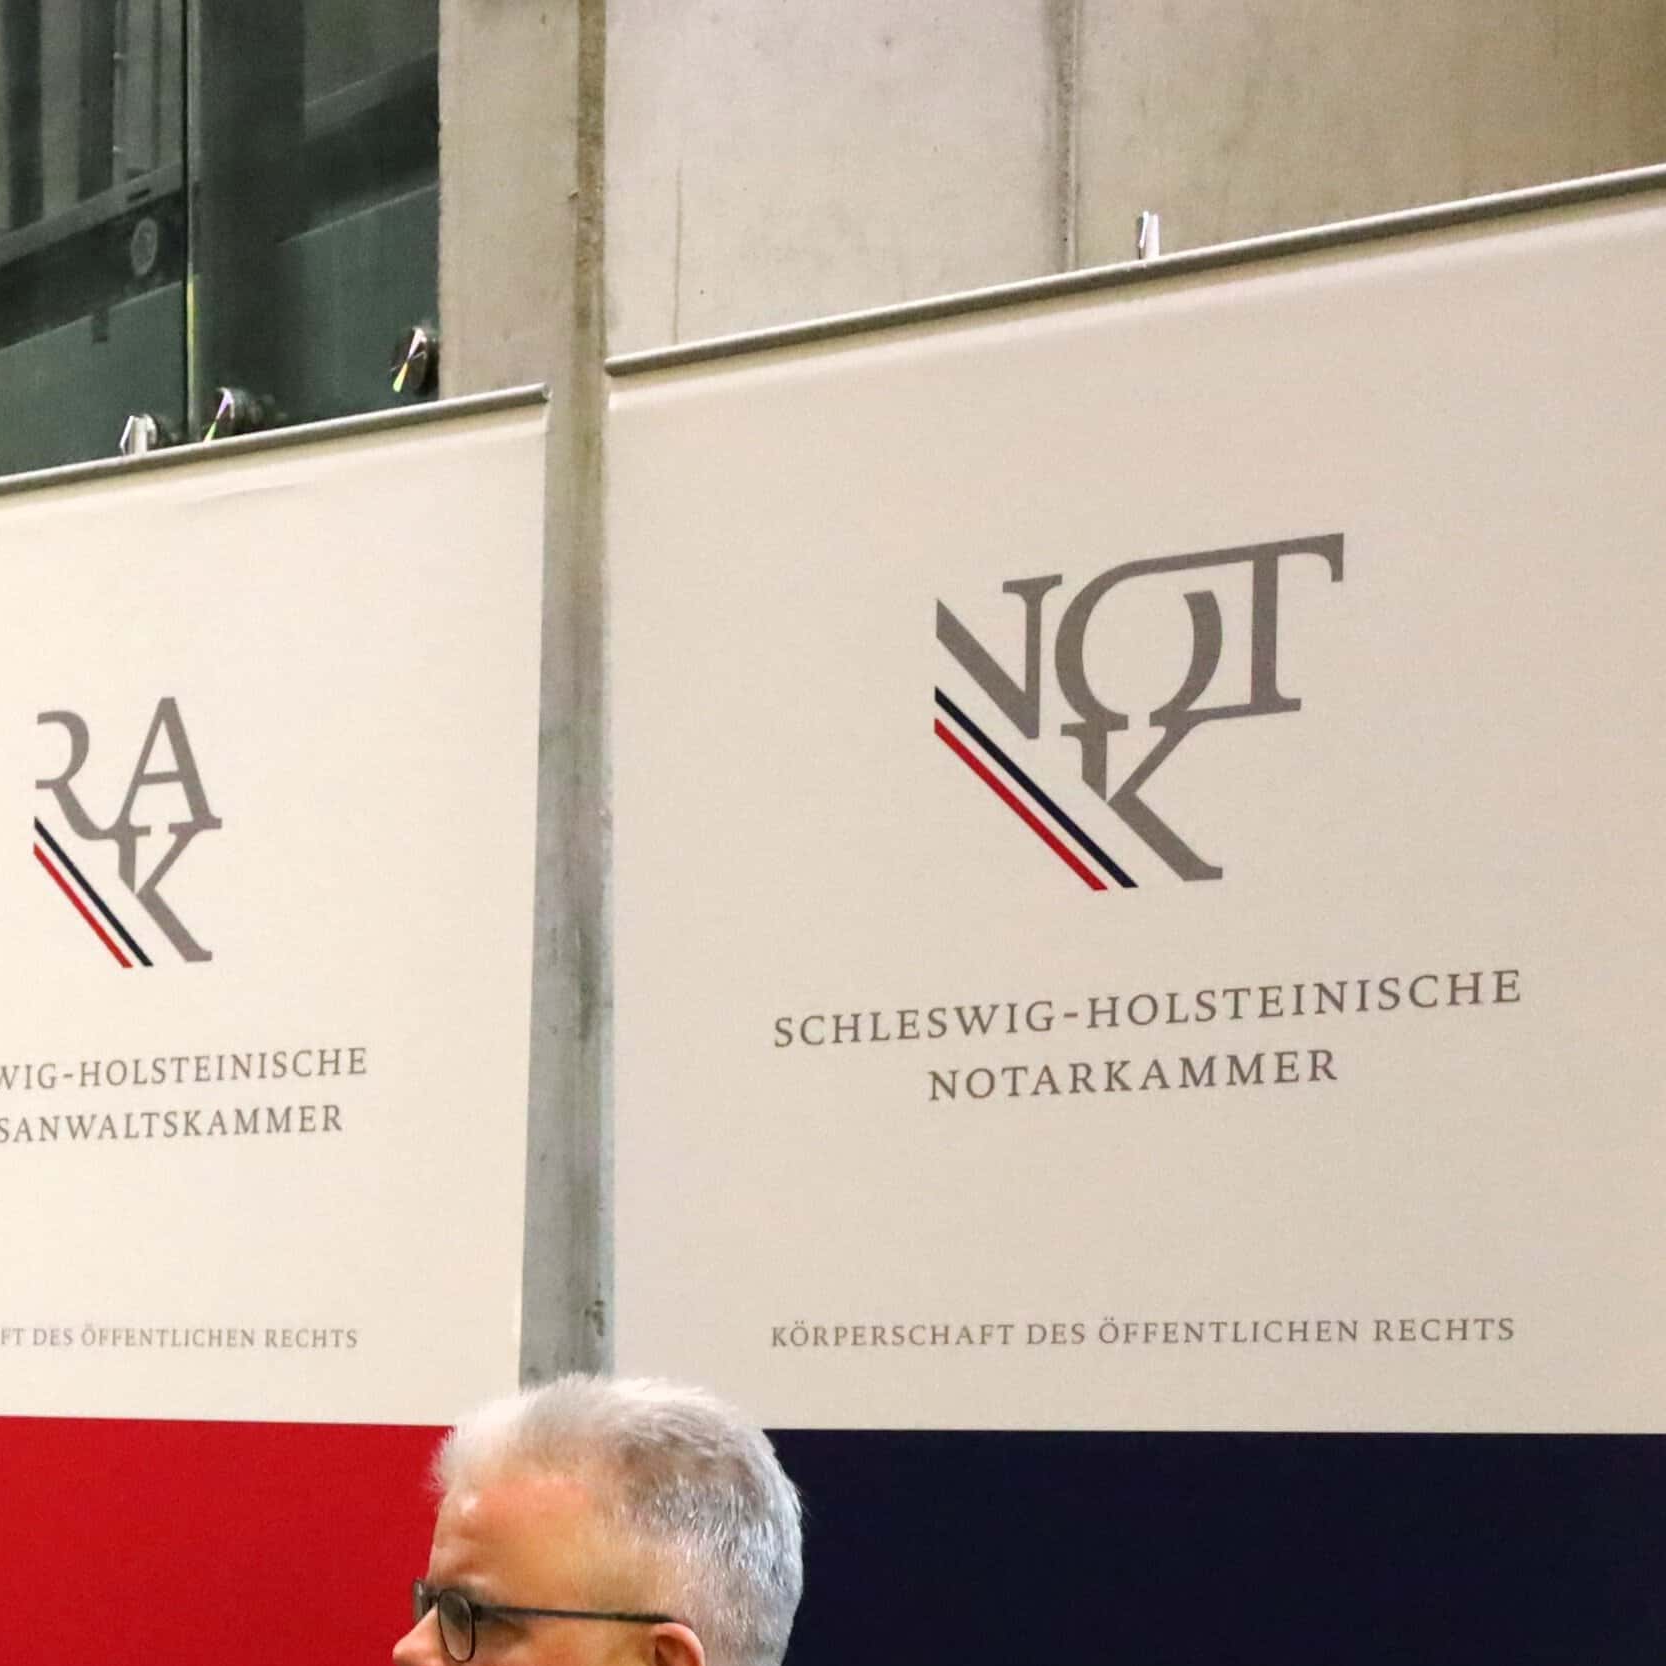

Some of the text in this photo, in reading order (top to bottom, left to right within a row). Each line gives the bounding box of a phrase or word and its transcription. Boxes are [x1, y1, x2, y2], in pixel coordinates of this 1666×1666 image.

[773, 968, 1522, 1050] SCHLESWIG-HOLSTEINISCHE
[926, 1048, 1339, 1101] NOTARKAMMER
[32, 1327, 74, 1347] DES
[80, 1325, 255, 1348] ÖFFENTLICHEN
[264, 1328, 358, 1349] RECHTS
[771, 1316, 1515, 1347] KÖRPERSCHAFT DES ÖFFENTLICHEN RECHTS
